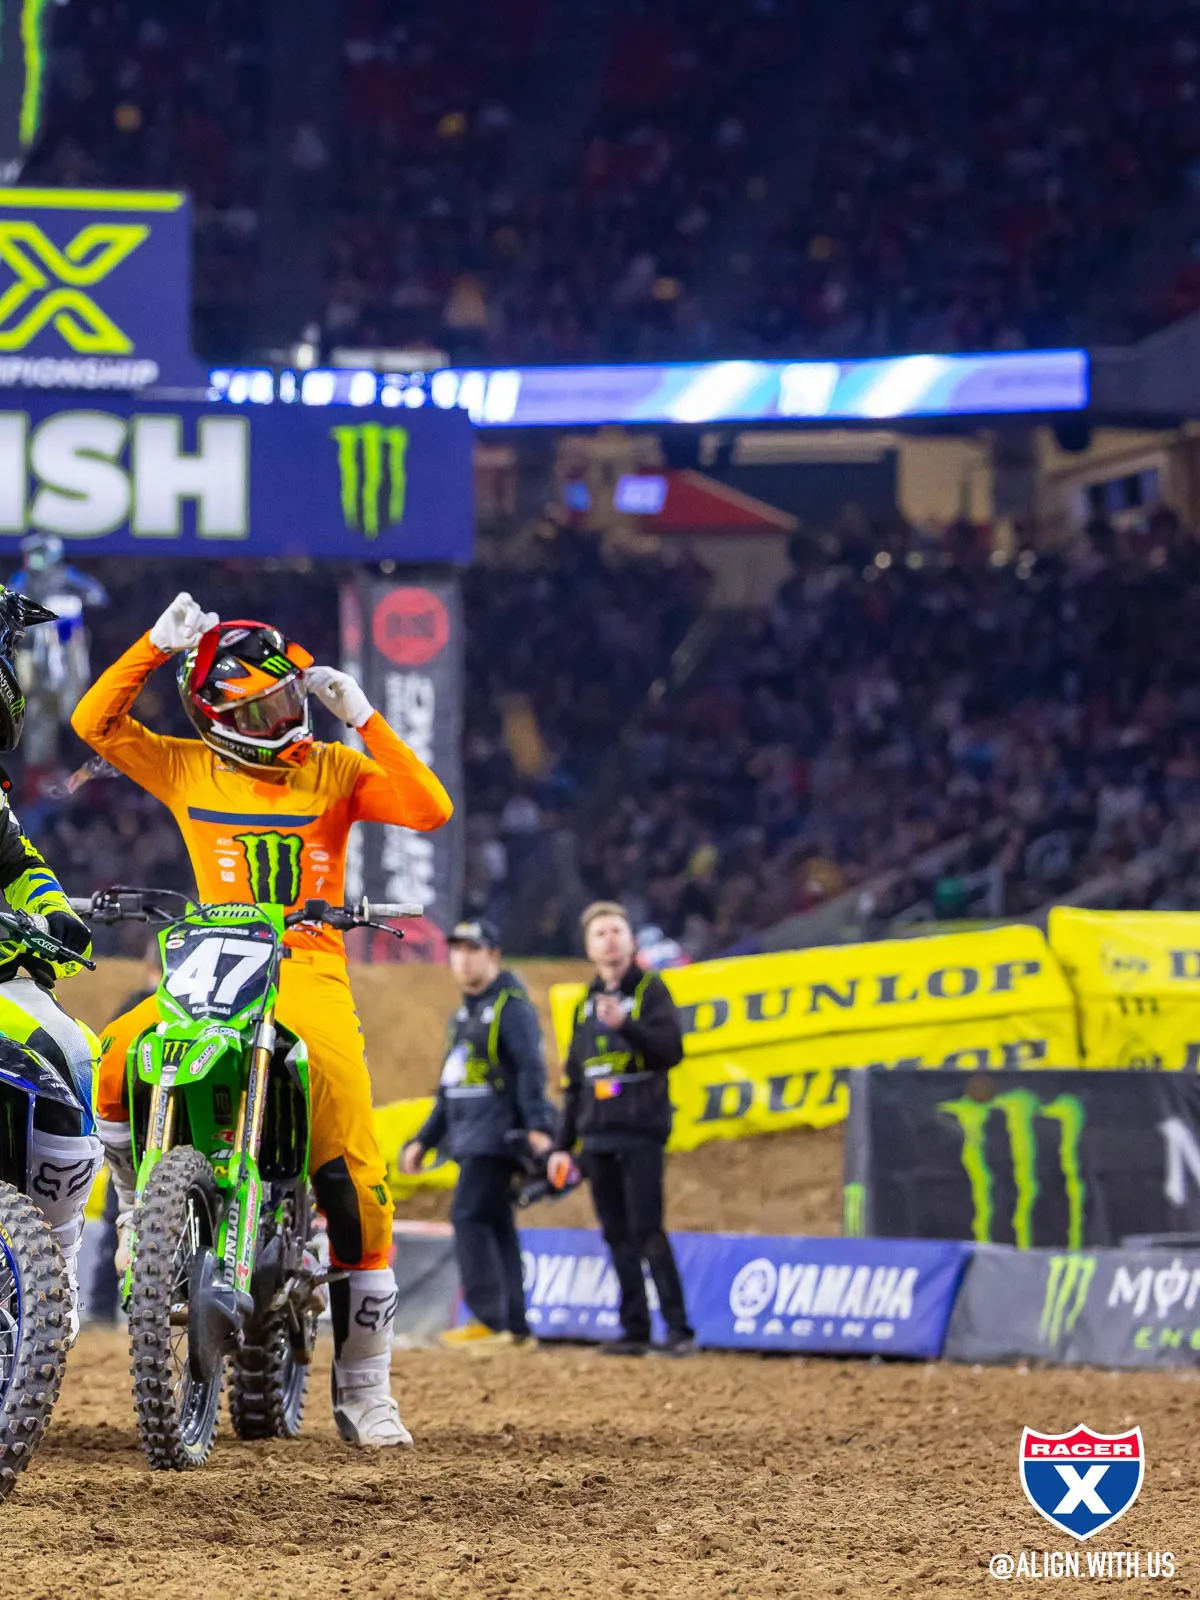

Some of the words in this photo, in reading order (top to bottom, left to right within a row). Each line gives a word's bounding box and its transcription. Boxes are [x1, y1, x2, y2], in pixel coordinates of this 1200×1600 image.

[166, 937, 273, 1005] 47
[677, 960, 1041, 1034] DUNLOP
[695, 1039, 1047, 1124] DUOP
[532, 1253, 661, 1312] YAMA
[773, 1262, 919, 1320] YAMAHA
[525, 1308, 621, 1328] ACIN
[733, 1318, 895, 1340] RACING
